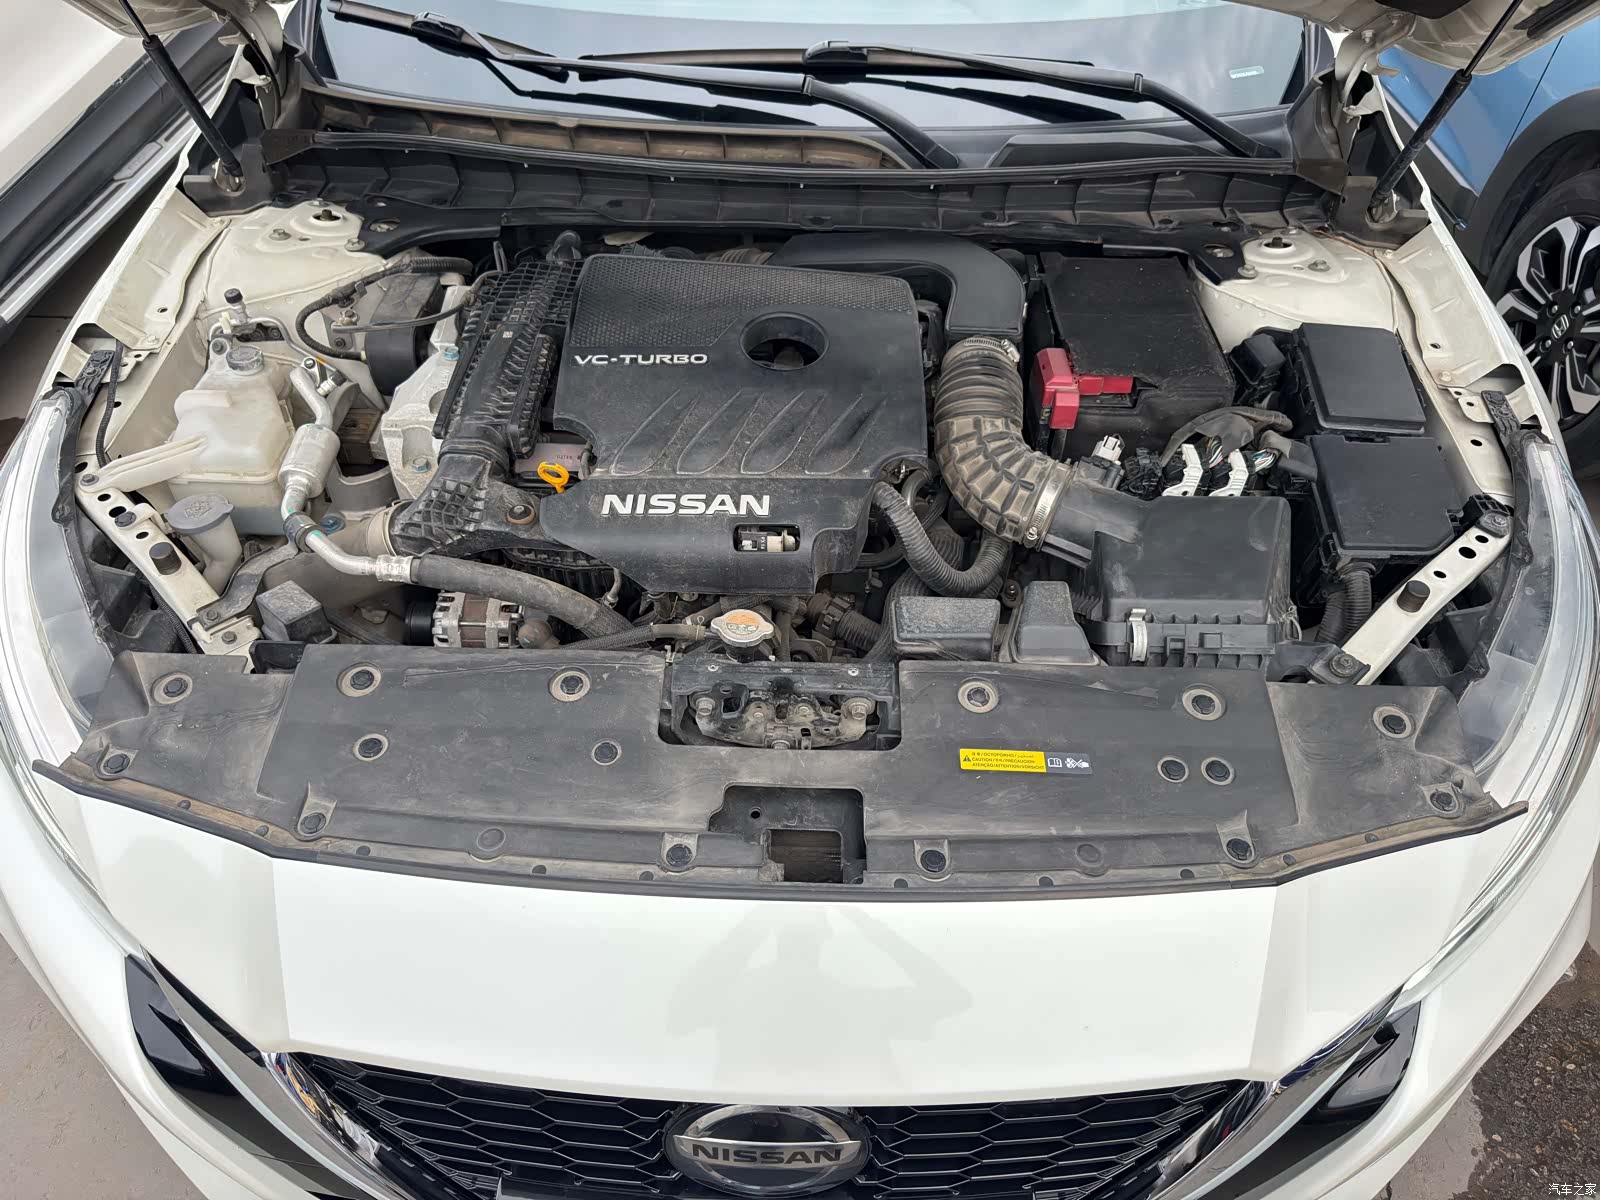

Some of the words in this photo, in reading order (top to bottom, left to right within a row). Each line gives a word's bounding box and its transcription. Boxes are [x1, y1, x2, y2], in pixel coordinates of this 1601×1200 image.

[574, 353, 708, 365] VC-TURBO
[601, 493, 771, 517] NISSAN
[692, 1143, 841, 1165] NISSAN
